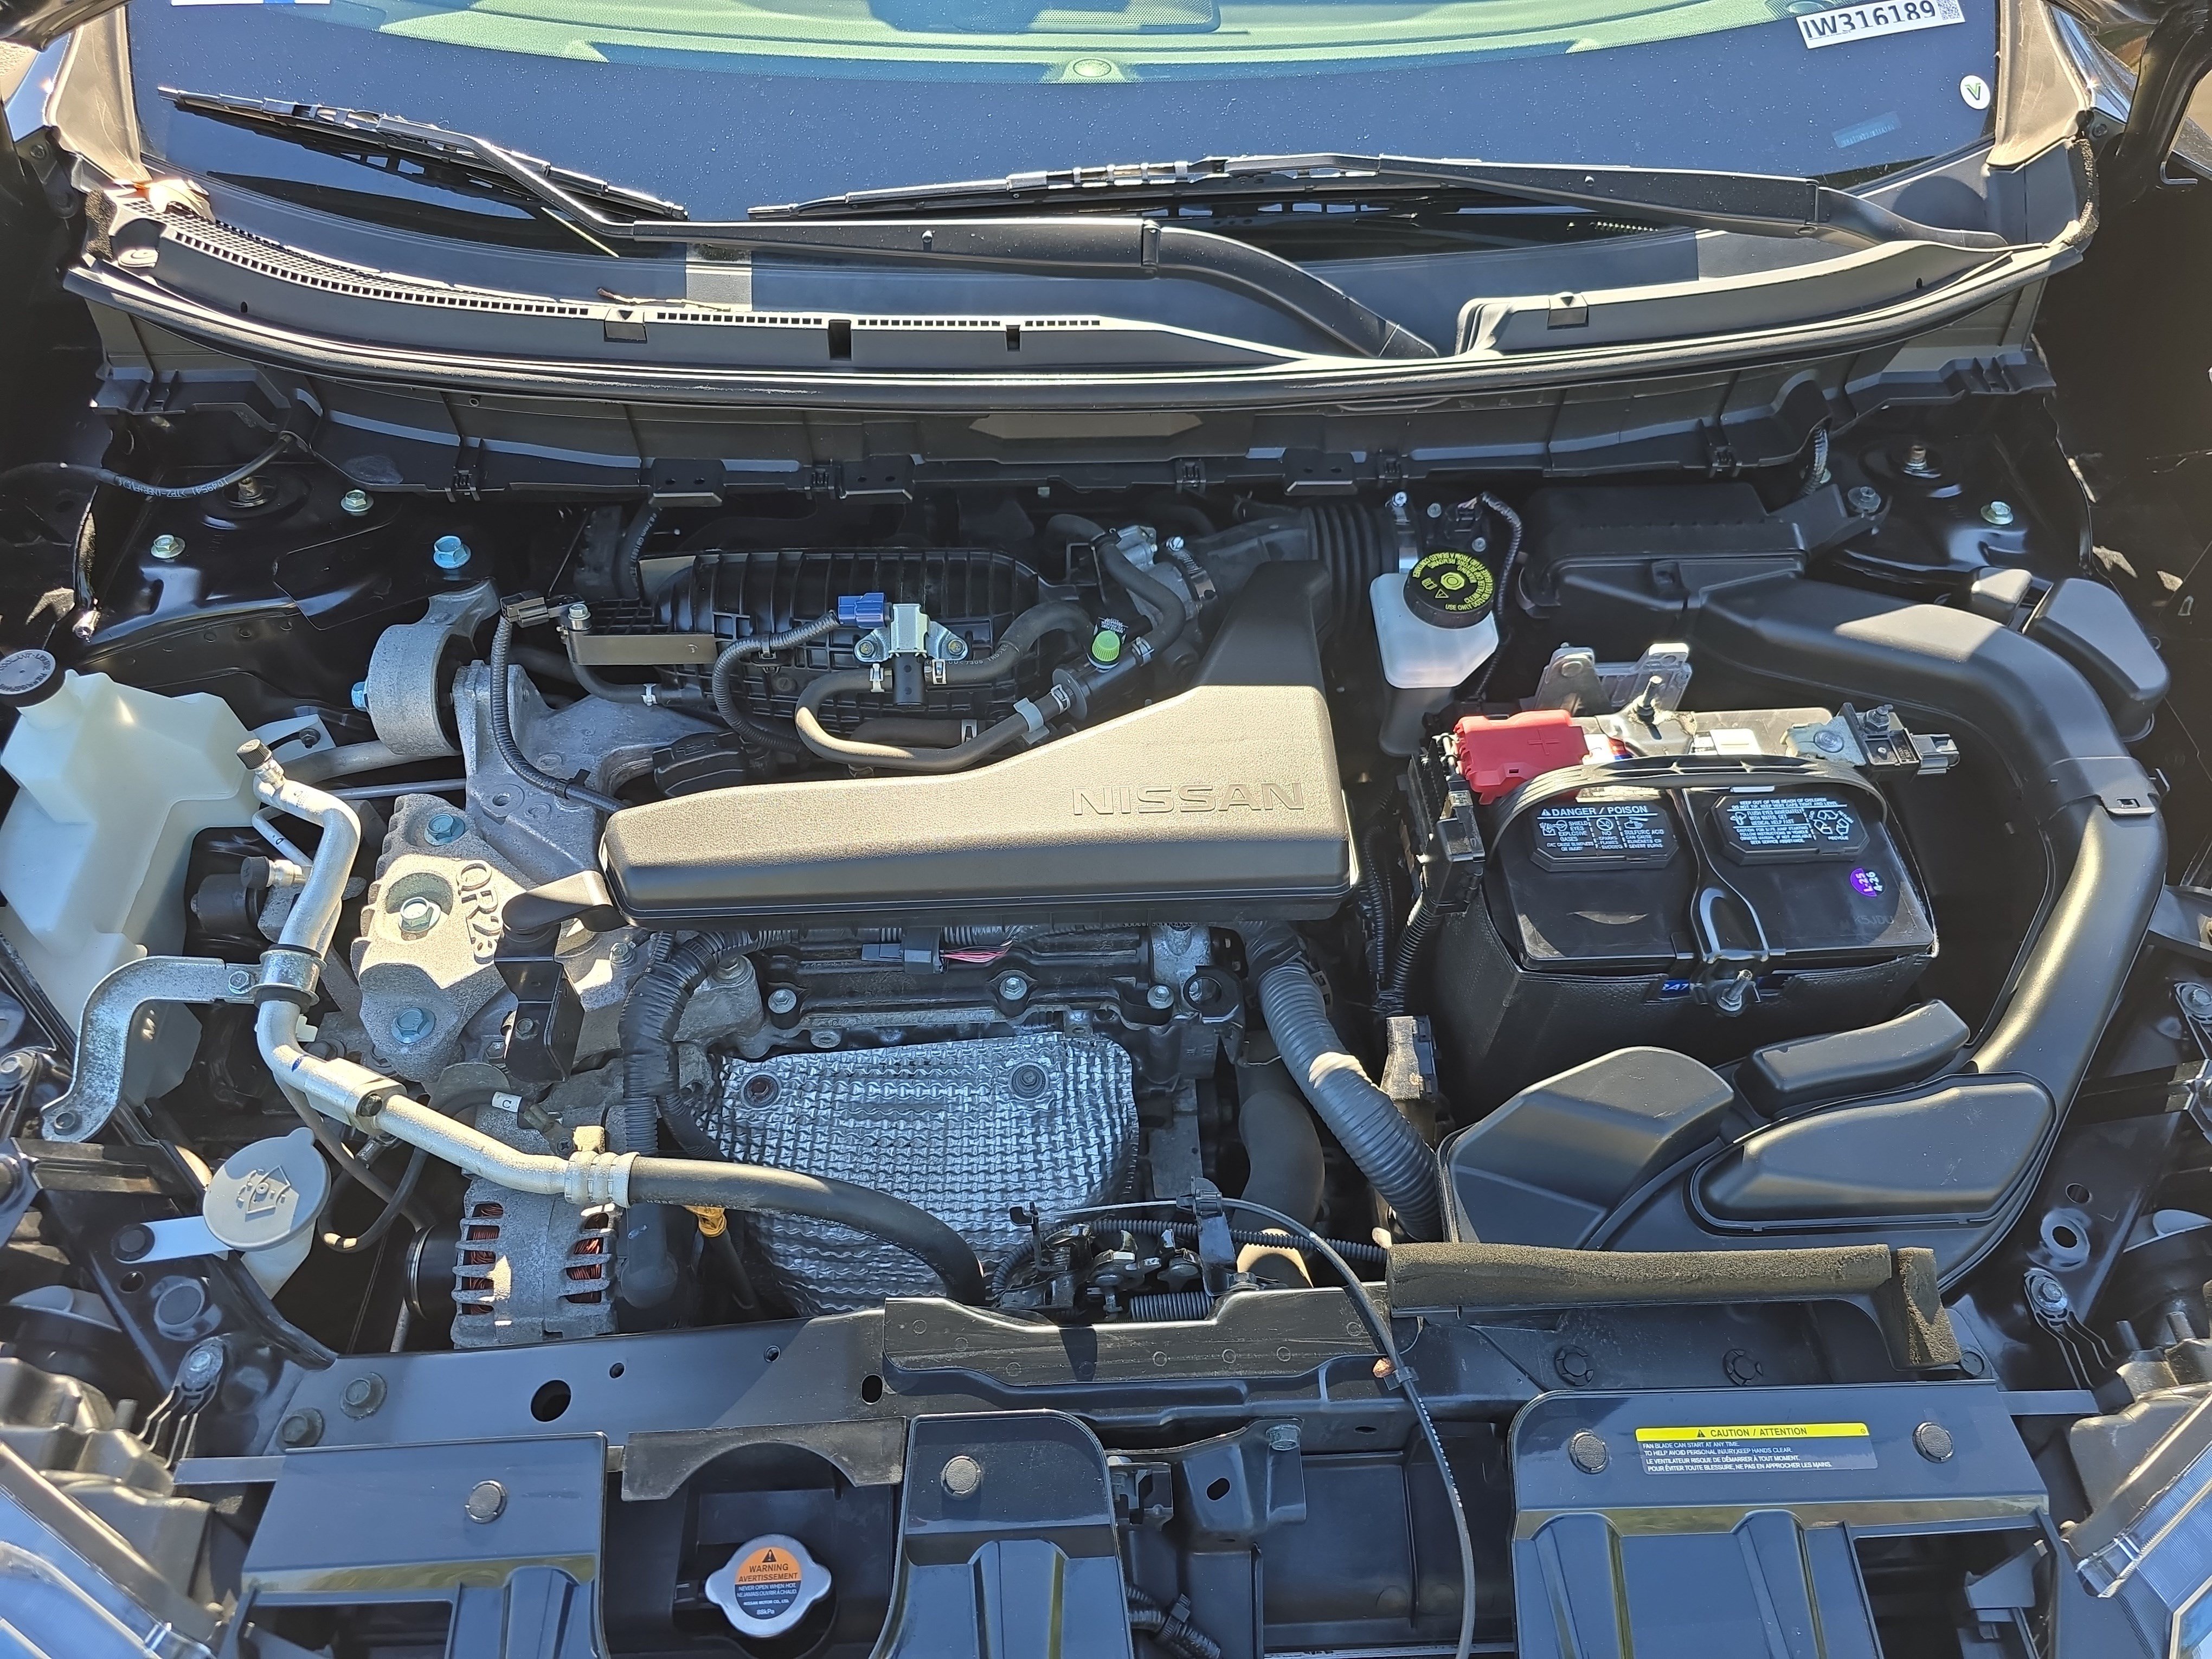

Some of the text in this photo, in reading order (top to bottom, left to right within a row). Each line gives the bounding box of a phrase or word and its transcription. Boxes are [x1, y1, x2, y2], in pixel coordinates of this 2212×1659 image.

[1802, 0, 1936, 38] IW316189
[1429, 552, 1449, 561] SEALED
[1455, 553, 1471, 562] FROM
[1073, 781, 1304, 815] NISSAN
[1552, 807, 1596, 816] DANGER
[1607, 805, 1648, 814] POISON
[1855, 872, 1873, 892] L-25
[502, 1099, 512, 1108] C
[1711, 1429, 1750, 1437] CAUTION
[1759, 1426, 1807, 1436] ATTENTION
[1721, 1454, 1751, 1463] DÉMARRER
[749, 1564, 788, 1572] WARNING
[738, 1572, 798, 1582] AVERTISSEMENT
